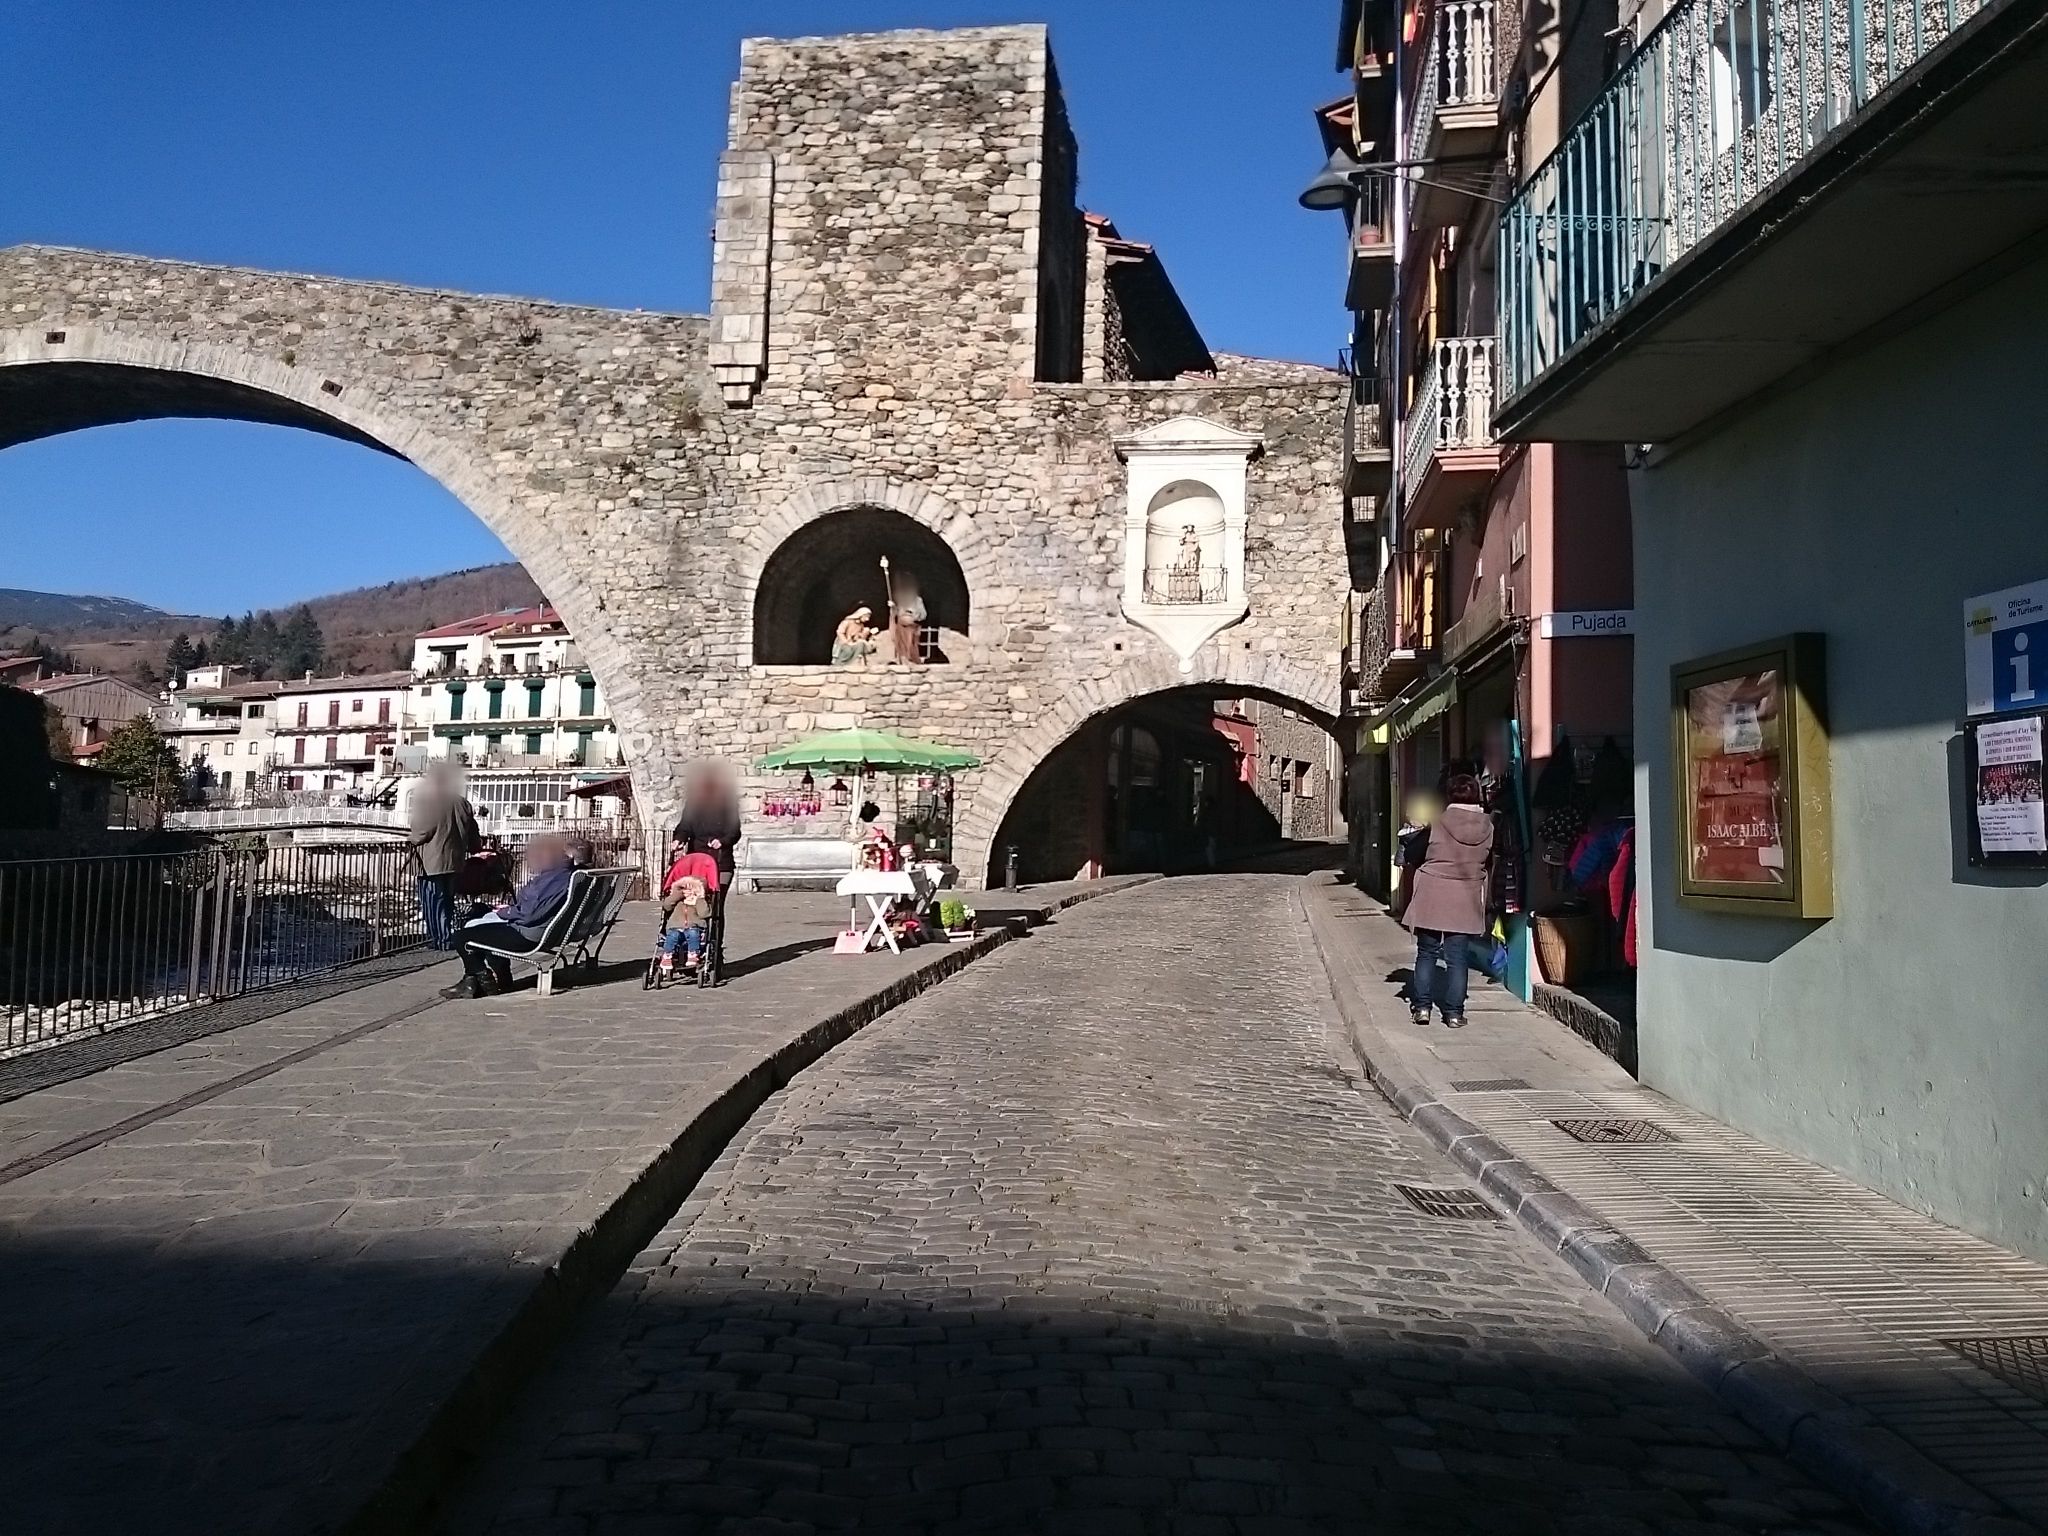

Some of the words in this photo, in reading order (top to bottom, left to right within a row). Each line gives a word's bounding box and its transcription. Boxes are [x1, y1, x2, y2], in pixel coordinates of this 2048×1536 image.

[2007, 598, 2031, 608] Oficina
[2008, 609, 2016, 618] de
[2017, 604, 2044, 616] Turisme
[1572, 613, 1626, 632] Pujada
[1707, 823, 1737, 838] ISAAC
